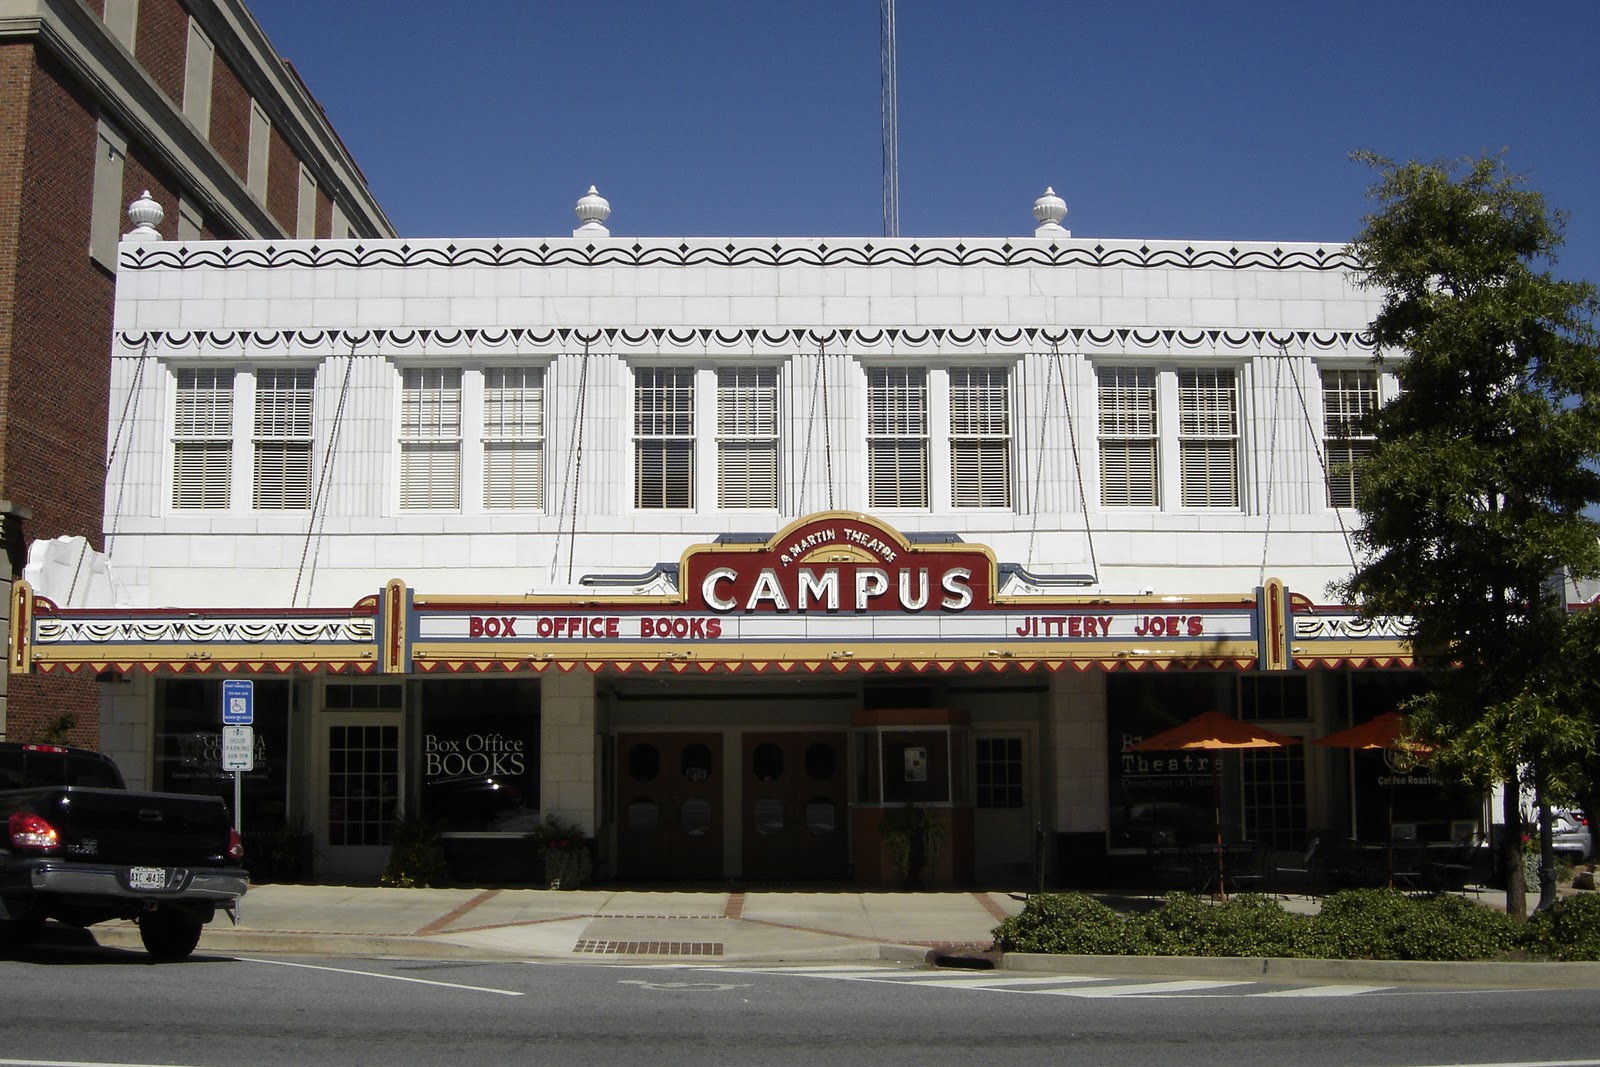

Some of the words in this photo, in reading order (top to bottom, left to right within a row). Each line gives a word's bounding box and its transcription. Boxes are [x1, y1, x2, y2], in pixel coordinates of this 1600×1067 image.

[780, 554, 793, 567] A
[789, 528, 836, 557] MARTIN
[844, 528, 898, 563] THEATRE
[701, 567, 974, 613] CAMPUS
[469, 617, 517, 637] BOX
[537, 616, 620, 637] OFFICE
[640, 617, 723, 638] BOOKS
[1016, 616, 1114, 637] JITTERY
[1134, 615, 1204, 637] JOE'S
[425, 734, 460, 752] Box
[466, 733, 524, 752] Office
[425, 752, 525, 775] BOOKS
